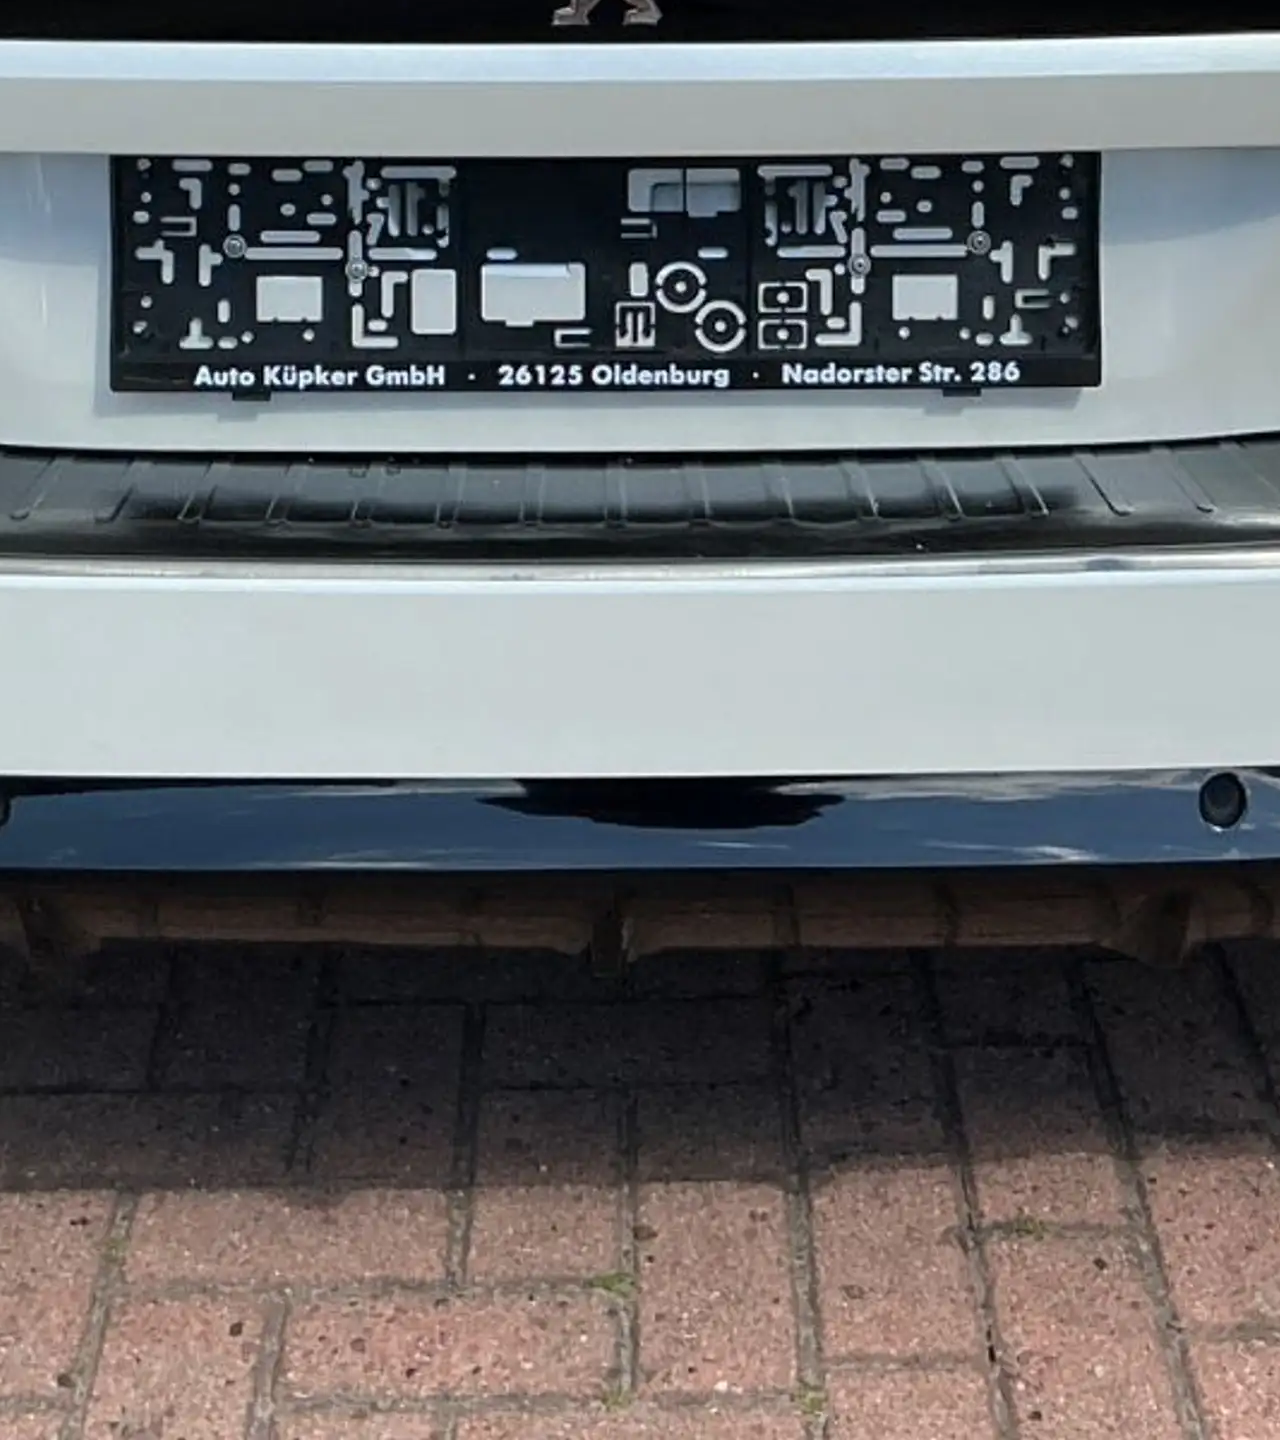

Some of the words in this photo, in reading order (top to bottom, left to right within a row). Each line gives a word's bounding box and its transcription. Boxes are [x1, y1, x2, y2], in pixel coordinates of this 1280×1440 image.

[194, 365, 255, 387] Auto
[263, 364, 358, 389] Küpker
[365, 364, 446, 387] GmbH
[498, 364, 583, 386] 26125
[591, 363, 730, 389] Oldenburg
[781, 362, 913, 384] Nadorster
[919, 361, 962, 383] Str.
[969, 360, 1020, 382] 286
